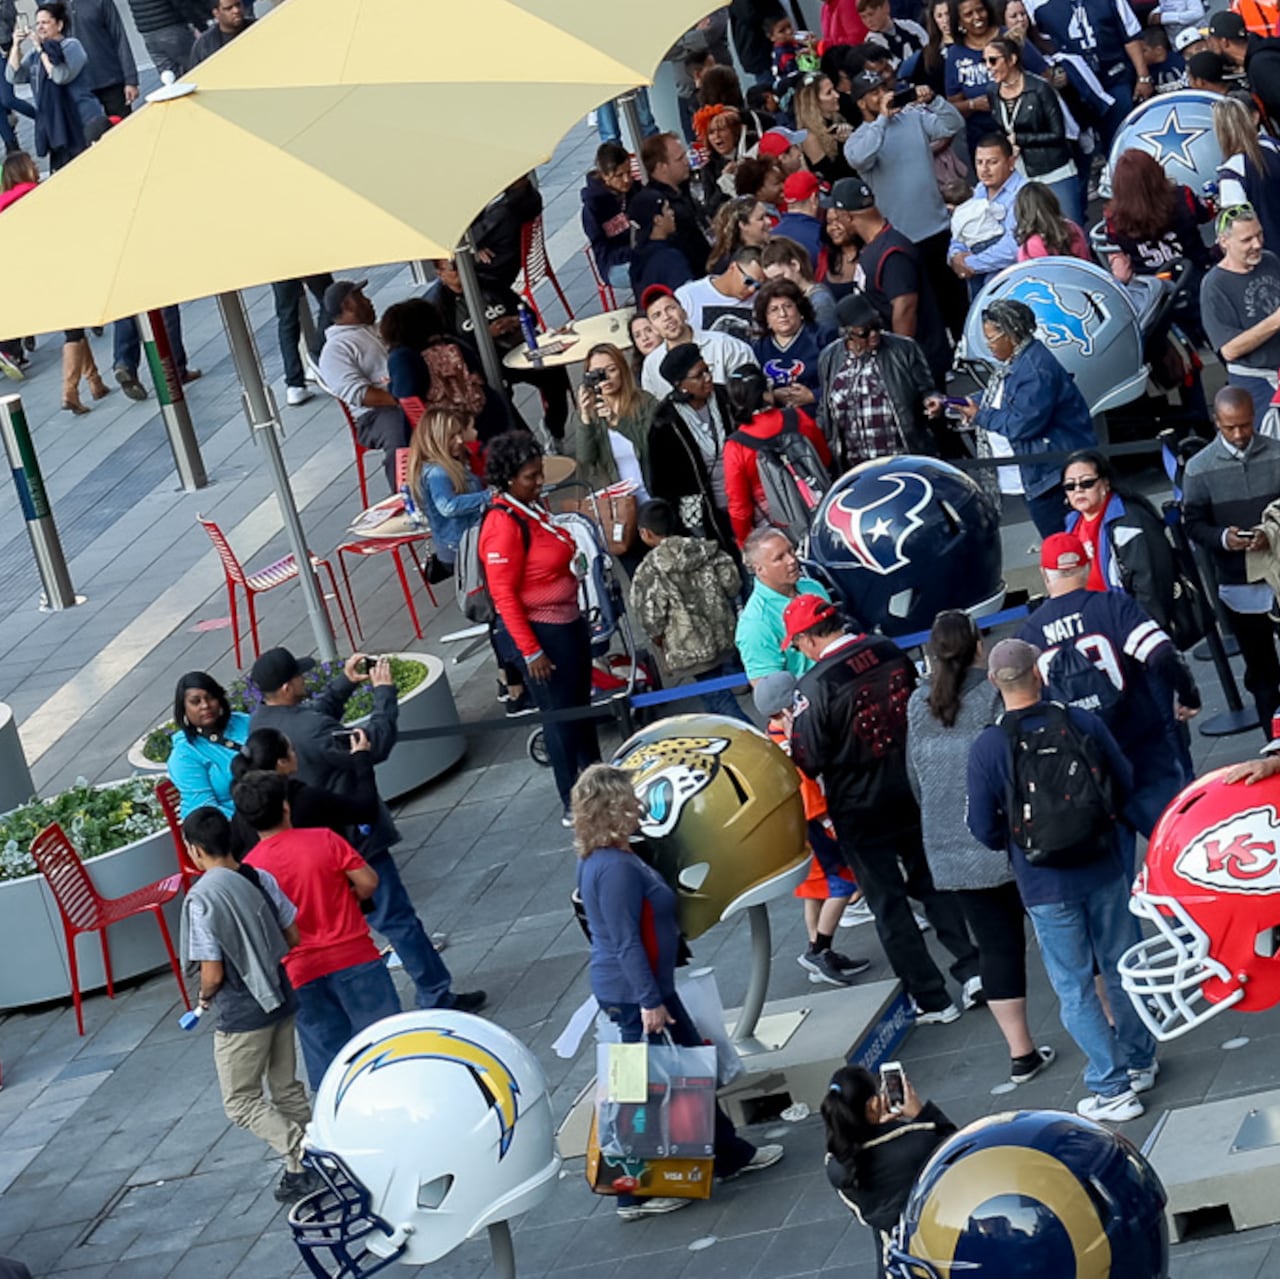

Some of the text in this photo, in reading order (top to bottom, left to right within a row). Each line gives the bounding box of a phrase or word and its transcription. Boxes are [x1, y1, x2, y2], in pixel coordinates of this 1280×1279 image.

[1069, 7, 1098, 51] 4
[1042, 611, 1085, 646] WATT
[845, 648, 880, 675] TATE
[1206, 832, 1277, 881] KC
[663, 1170, 684, 1182] VISA
